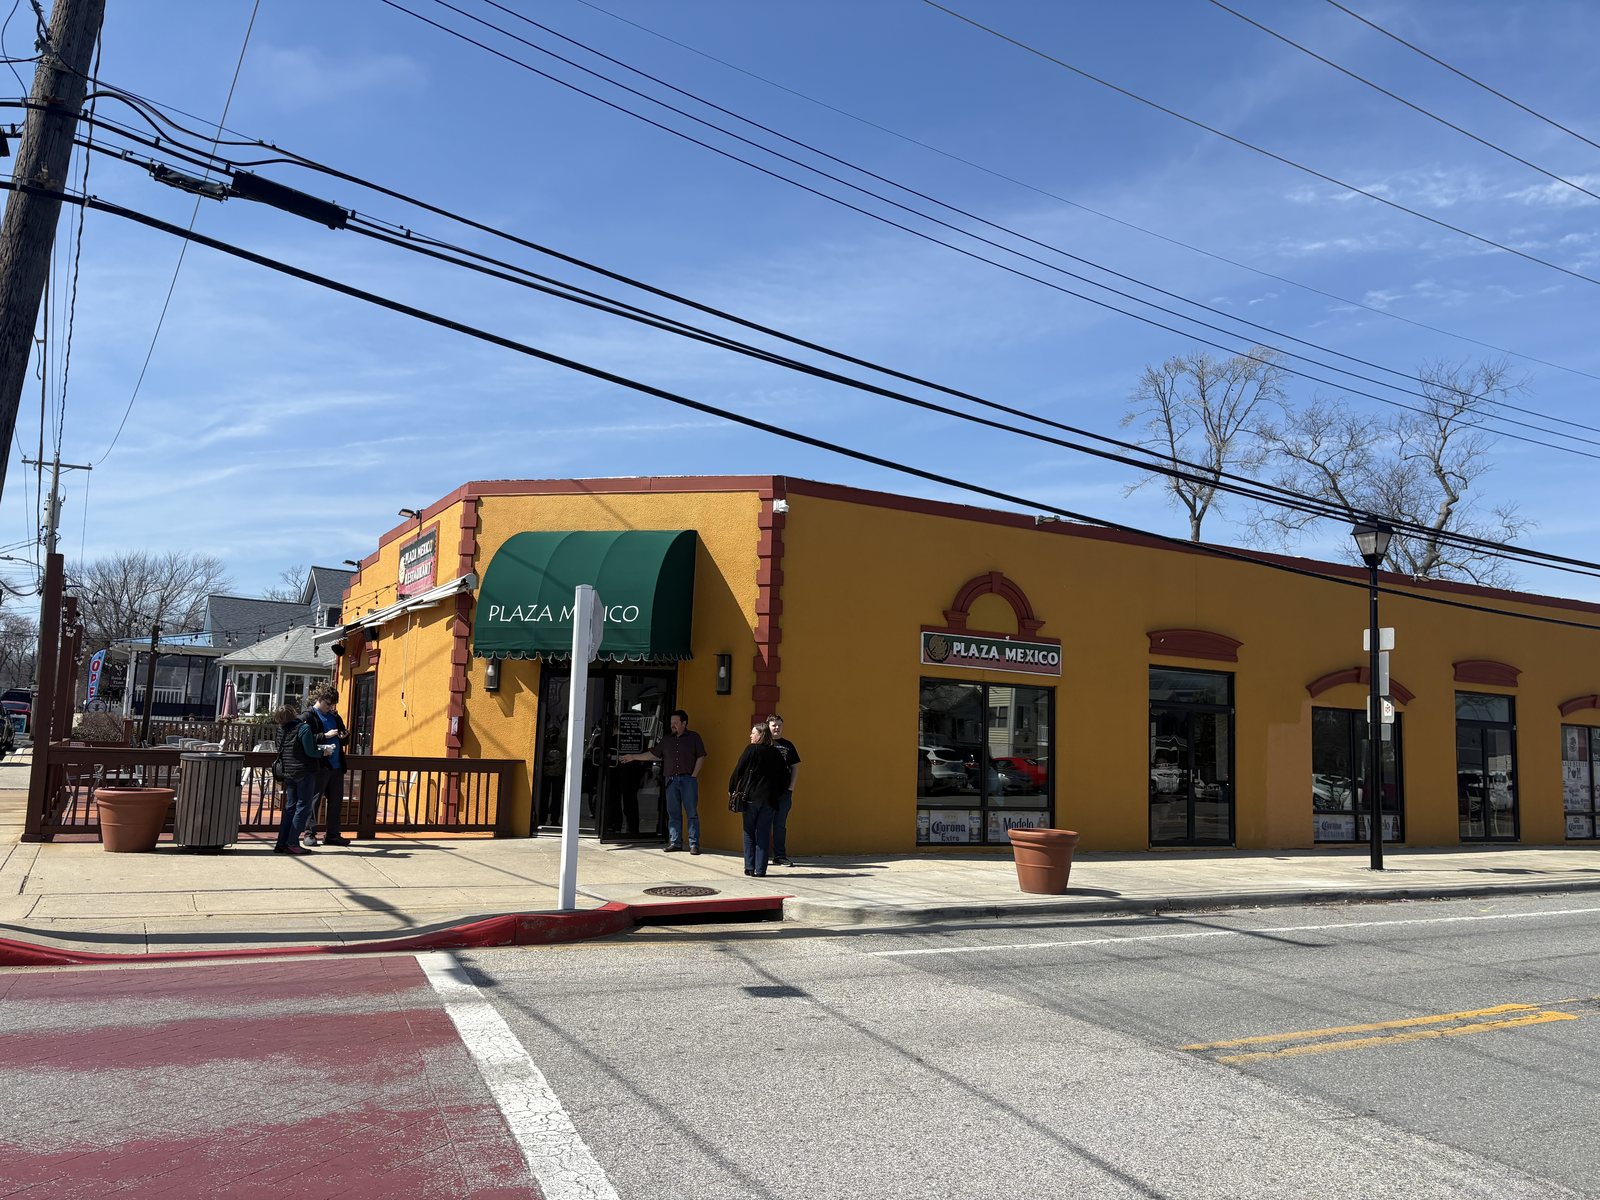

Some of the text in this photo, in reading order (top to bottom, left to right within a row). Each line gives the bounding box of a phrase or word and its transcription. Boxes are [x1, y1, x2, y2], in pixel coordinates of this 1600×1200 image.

[488, 604, 640, 623] PLAZA MICO
[952, 641, 1059, 666] PLAZA MEXICO
[90, 660, 101, 701] OPE
[931, 821, 966, 835] Corona
[941, 833, 960, 842] Extra
